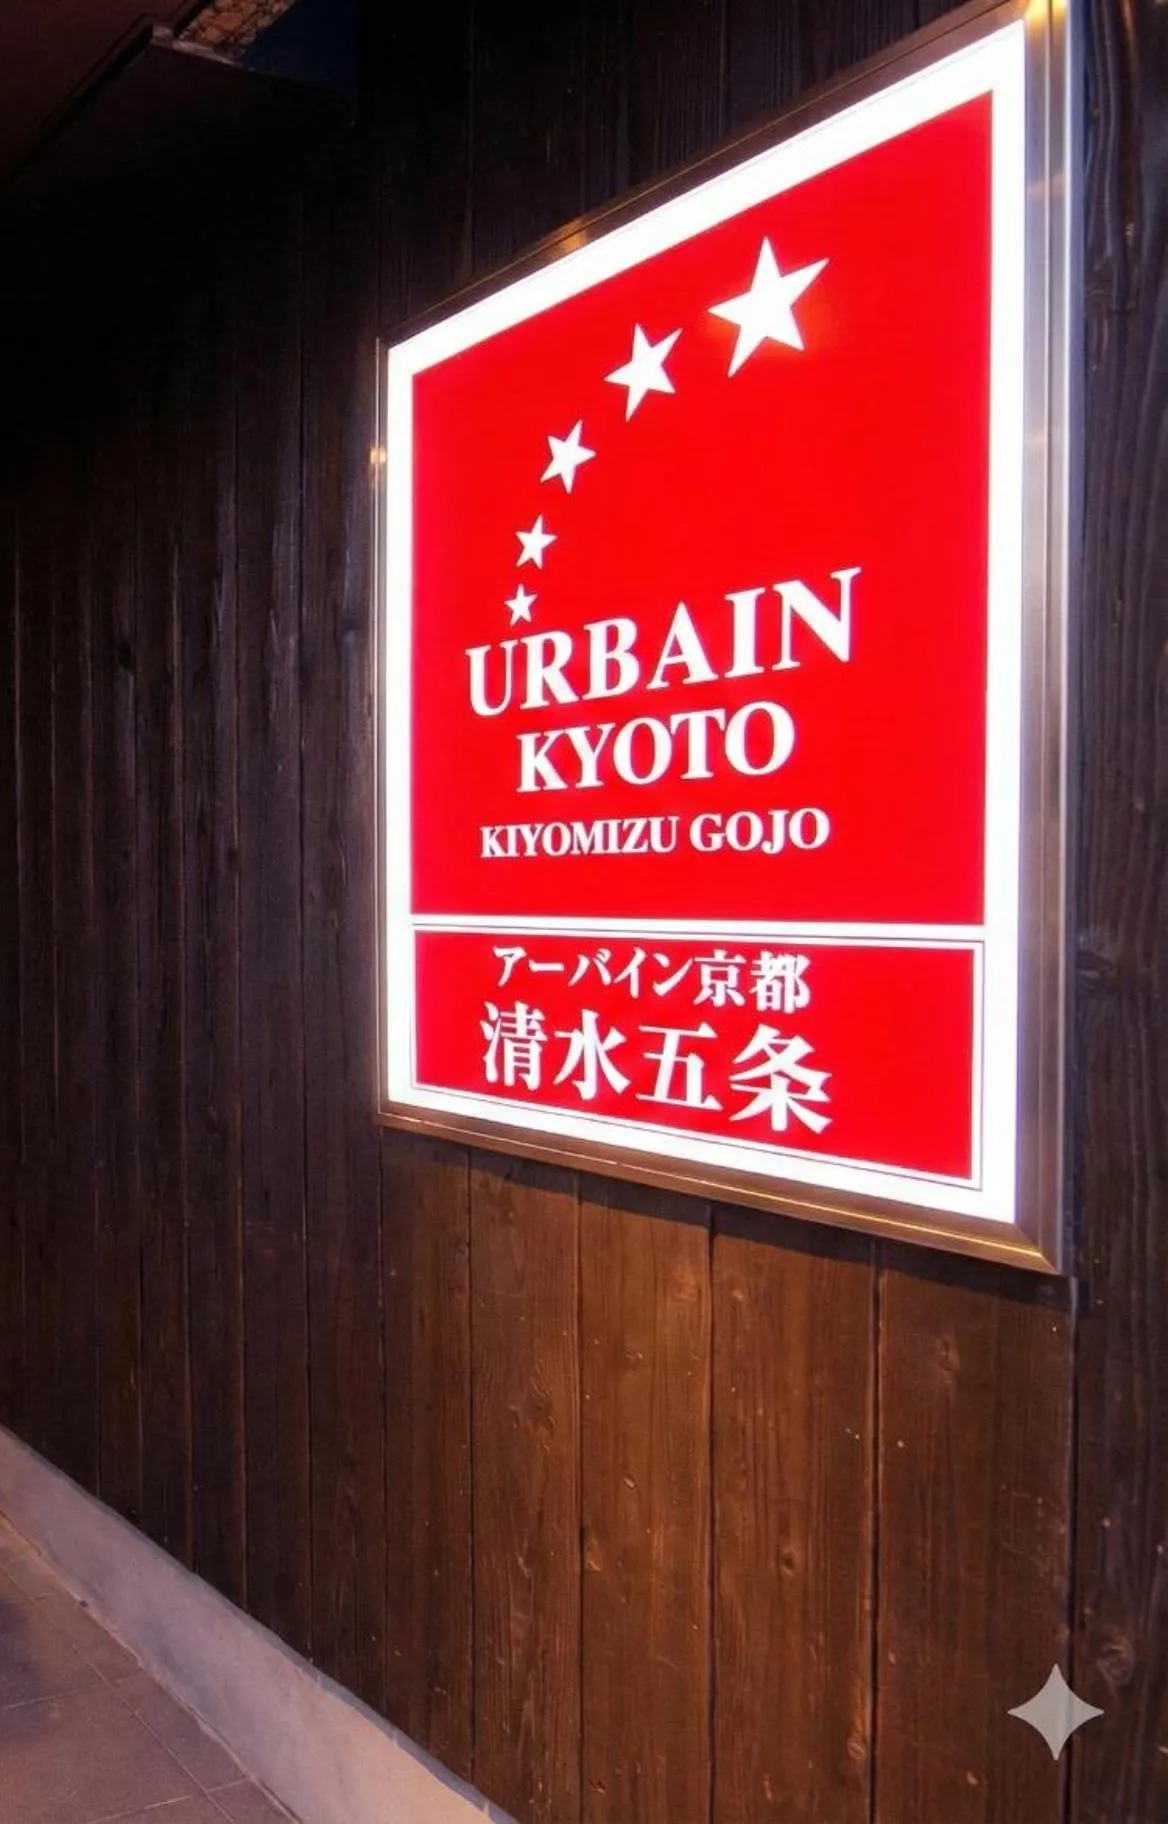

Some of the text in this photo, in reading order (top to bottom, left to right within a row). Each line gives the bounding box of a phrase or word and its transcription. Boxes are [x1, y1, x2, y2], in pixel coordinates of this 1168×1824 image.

[465, 566, 861, 717] URBAIN
[517, 701, 795, 793] KYOTO
[480, 807, 830, 858] KIYOMIZU GOJO
[492, 945, 812, 1014] アーバイン京都
[480, 1001, 833, 1135] 清水五条
